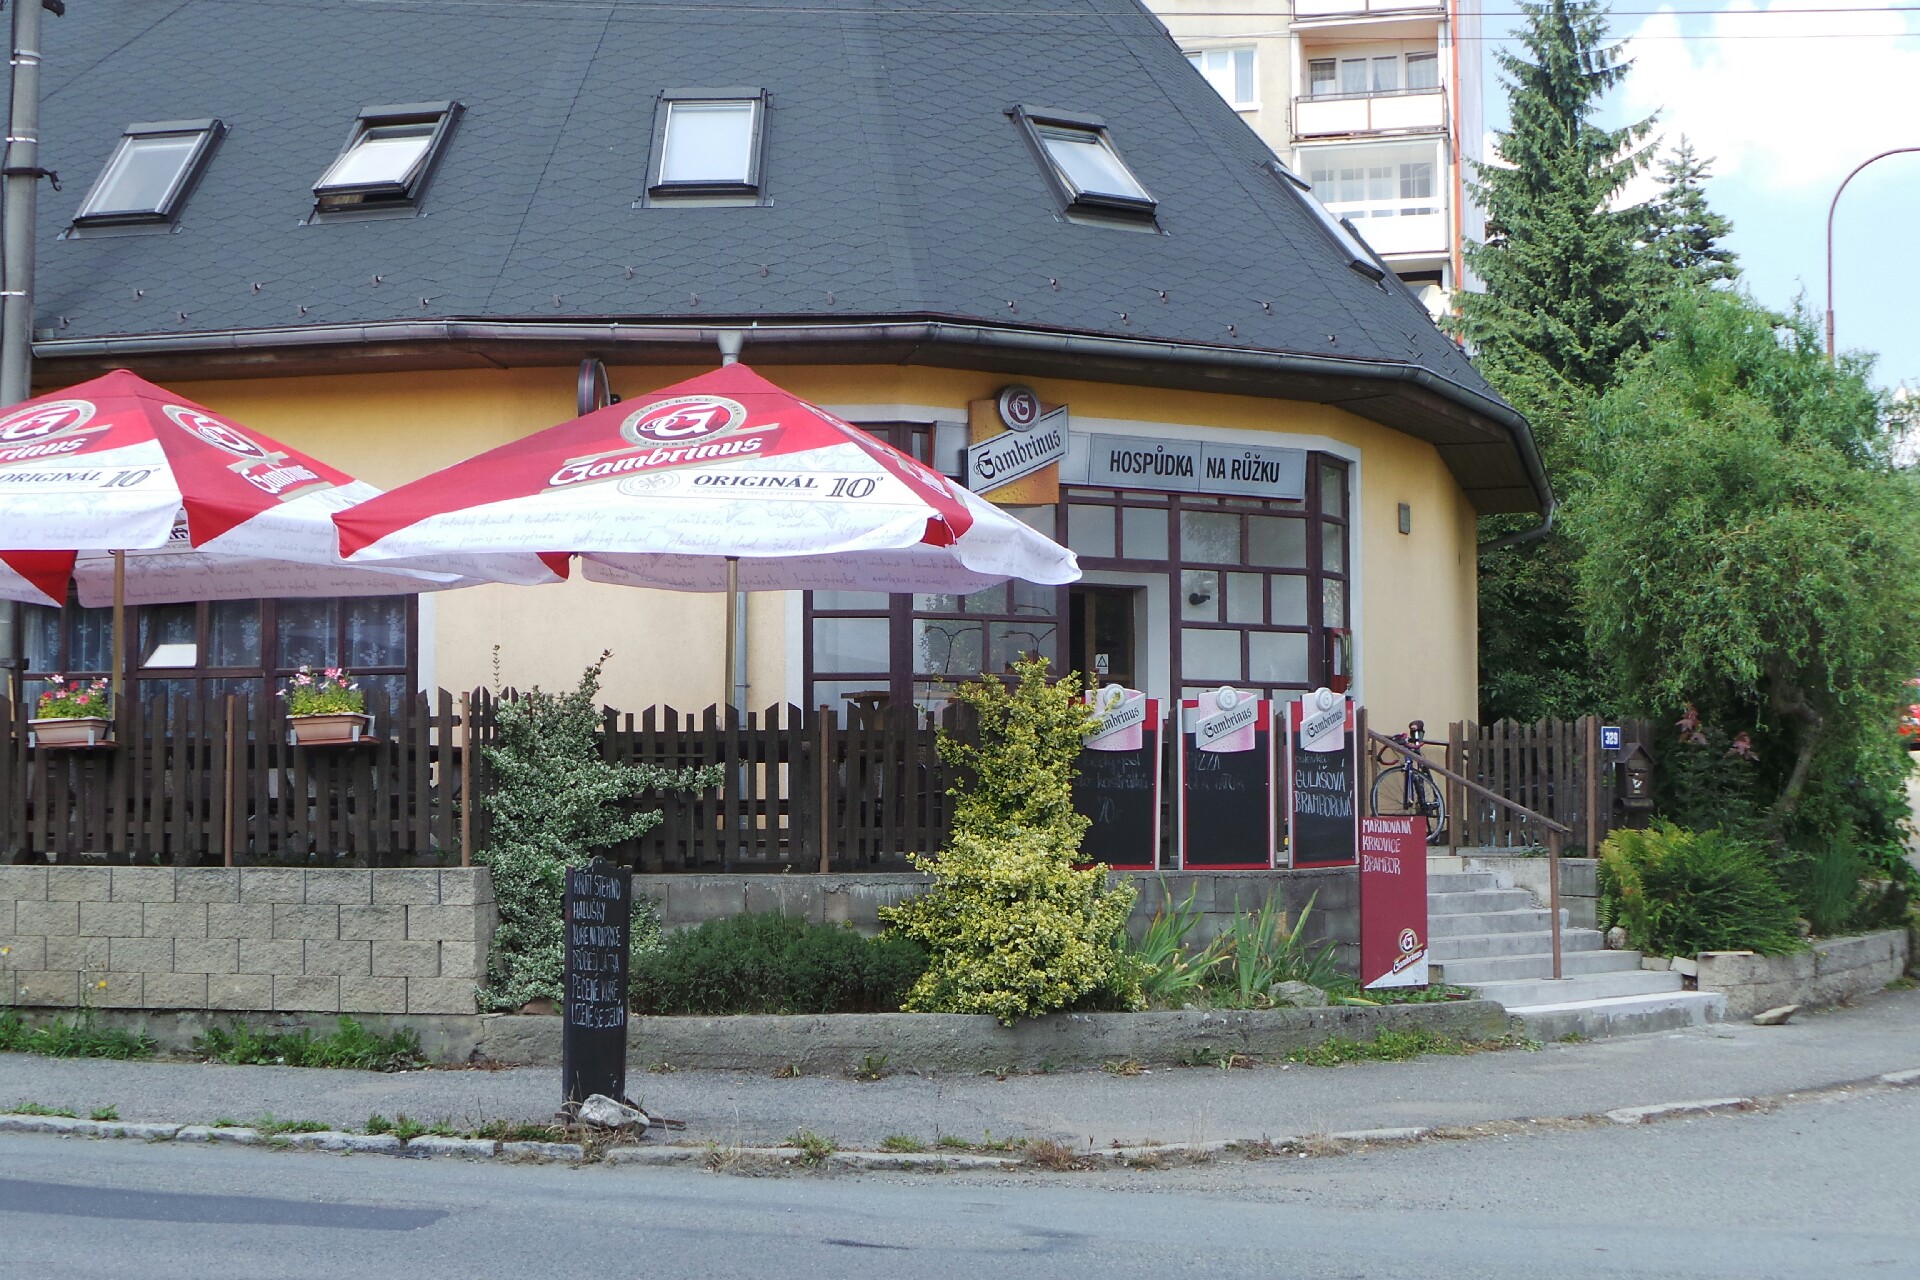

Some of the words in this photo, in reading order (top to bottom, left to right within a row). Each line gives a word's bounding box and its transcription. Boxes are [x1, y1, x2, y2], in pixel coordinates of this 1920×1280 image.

[0, 438, 88, 461] rinus
[549, 437, 763, 486] Gambrinus
[973, 430, 1061, 479] Gambrinus
[1109, 445, 1194, 477] HOSPŮDKA
[1206, 457, 1226, 479] NA
[1230, 452, 1280, 483] RŮŽKU
[693, 475, 819, 489] ORIGINÁL
[1203, 708, 1252, 738] Gambrinus
[1307, 709, 1343, 738] Gambrinus
[1604, 731, 1619, 745] 329
[1295, 759, 1346, 792] GULÁŠOVÁ
[1362, 816, 1413, 835] MARINOVANÁ
[1362, 835, 1401, 853] KRKOVICE
[1362, 854, 1401, 875] BRAMBOR
[594, 874, 621, 901] STEHNO
[573, 898, 605, 924] HALUŠKY
